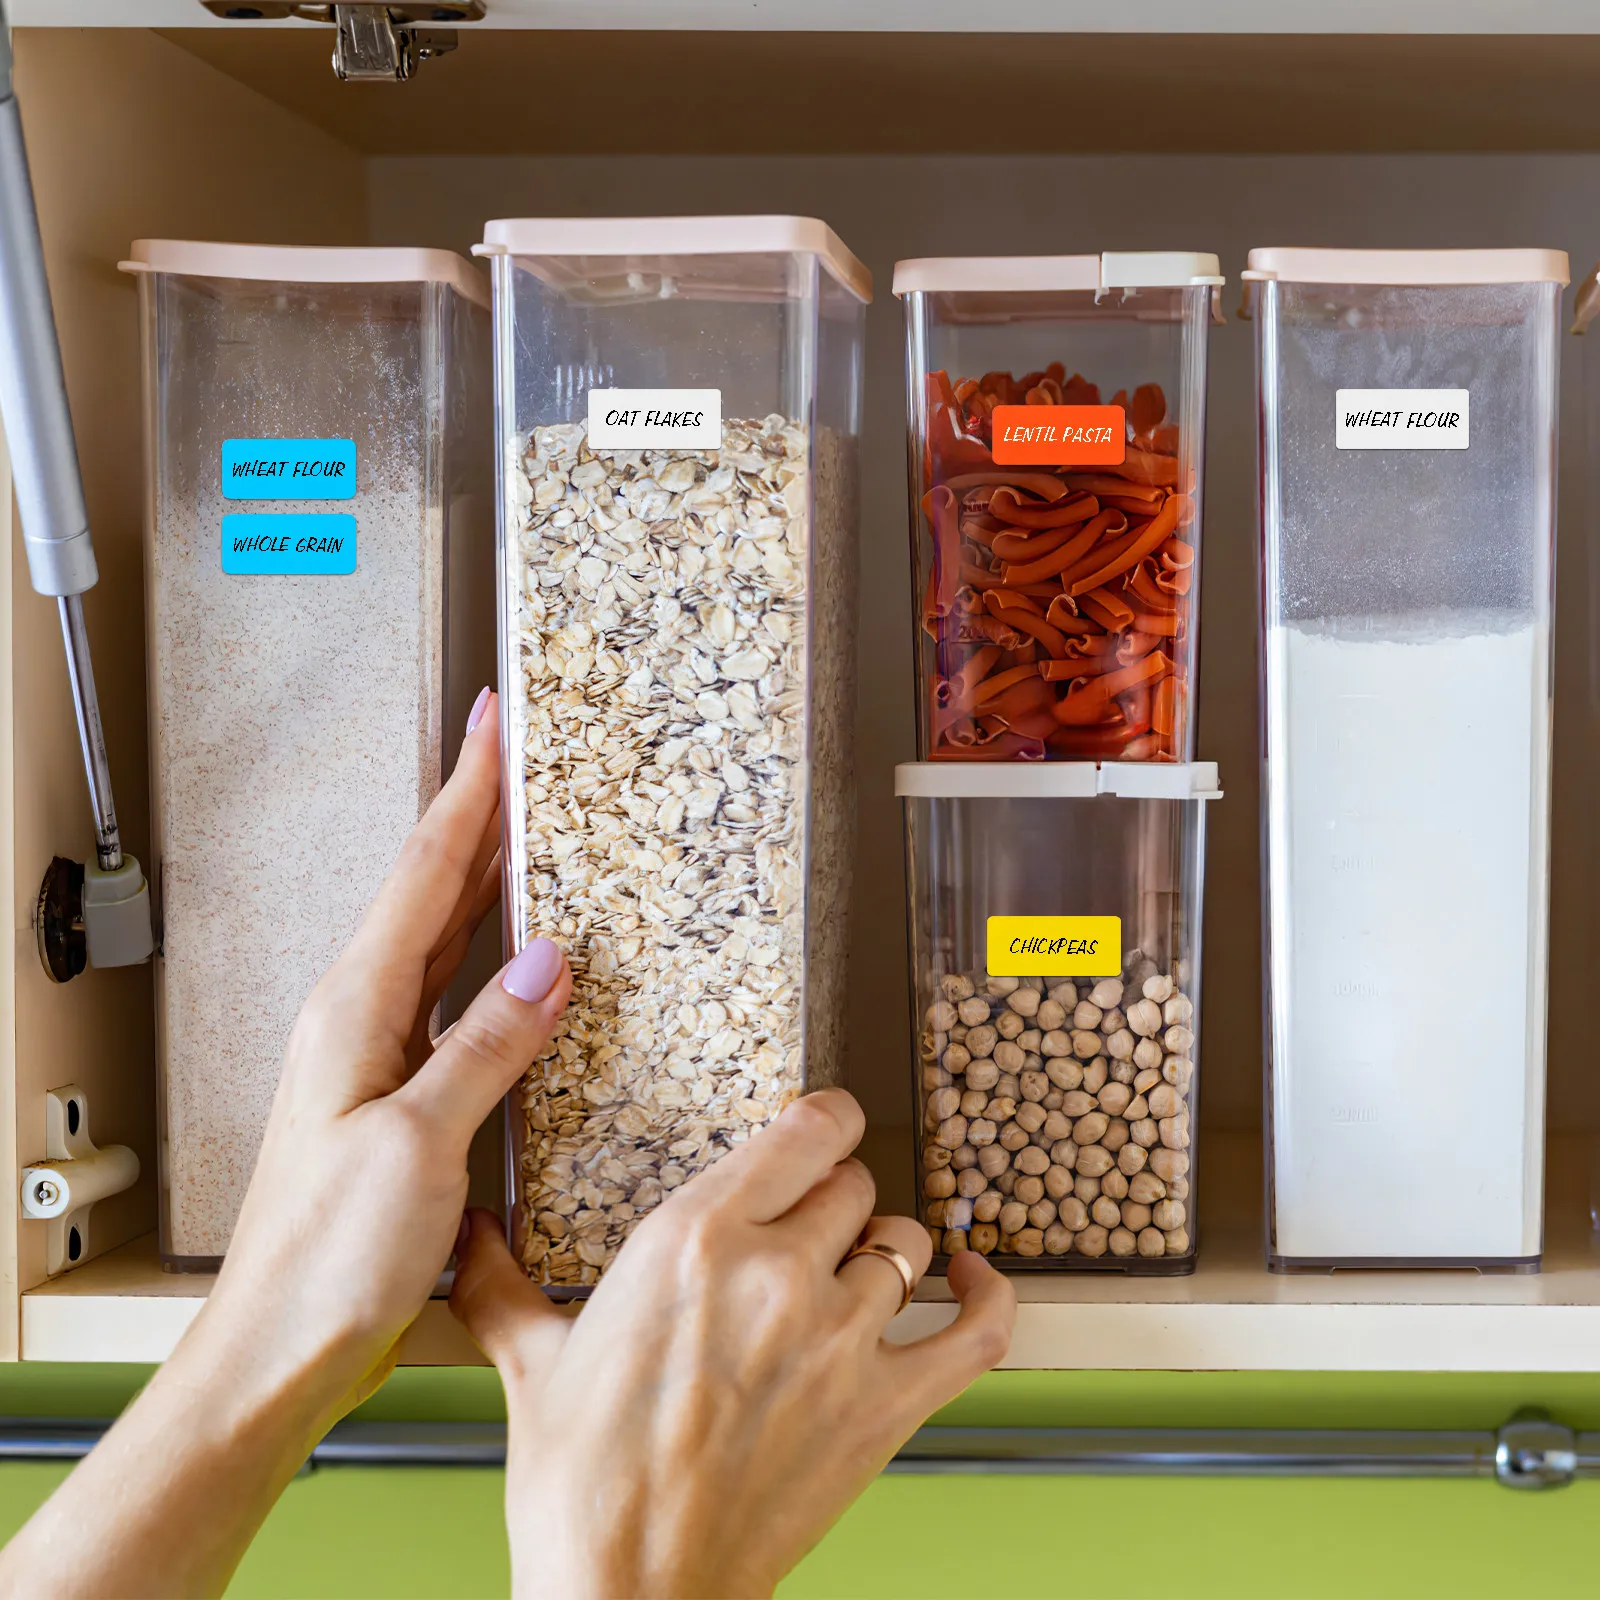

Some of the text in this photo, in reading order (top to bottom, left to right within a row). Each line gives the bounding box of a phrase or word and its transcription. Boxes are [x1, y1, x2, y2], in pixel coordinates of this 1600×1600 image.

[606, 410, 704, 428] OAT FLAKES
[1345, 410, 1460, 429] WHEAT FLOUR
[1003, 426, 1113, 444] LENTIL PASTA
[232, 460, 346, 478] WHEAT FLOUR
[233, 535, 345, 554] WHOLE GRAIN
[1009, 937, 1099, 955] CHICKPEAS
